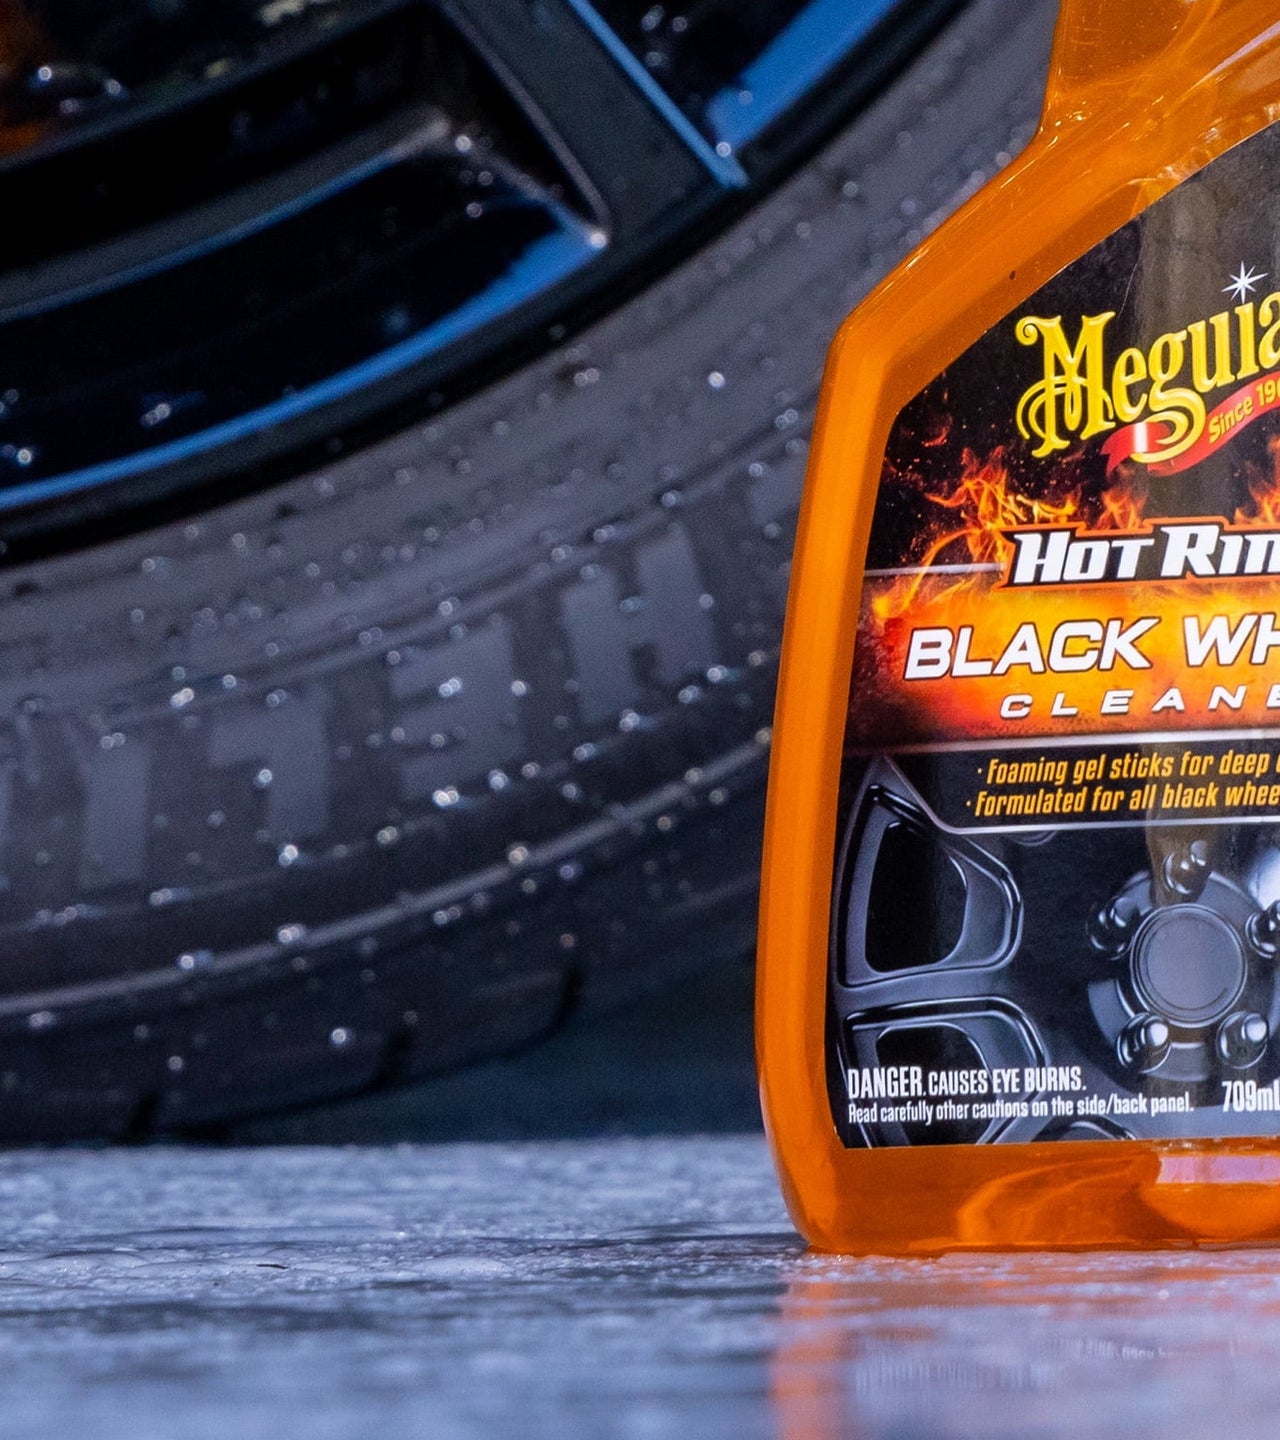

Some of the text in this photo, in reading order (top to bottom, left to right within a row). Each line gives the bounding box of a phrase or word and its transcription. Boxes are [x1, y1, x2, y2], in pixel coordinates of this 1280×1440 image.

[1208, 396, 1254, 444] Since
[902, 616, 1161, 681] BLACK
[986, 756, 1068, 786] Foaming
[1072, 753, 1107, 785] gel
[1109, 752, 1175, 779] sticks
[1179, 750, 1215, 776] for
[1218, 749, 1271, 778] deep
[975, 786, 1089, 817] Formulated
[1091, 785, 1125, 812] for
[1129, 783, 1158, 810] all
[1161, 781, 1220, 809] black
[847, 1066, 1087, 1099] DANGER. CAUSES EYE BURNS.
[848, 1091, 1195, 1127] Read carefully other cautions on the side/back panel.
